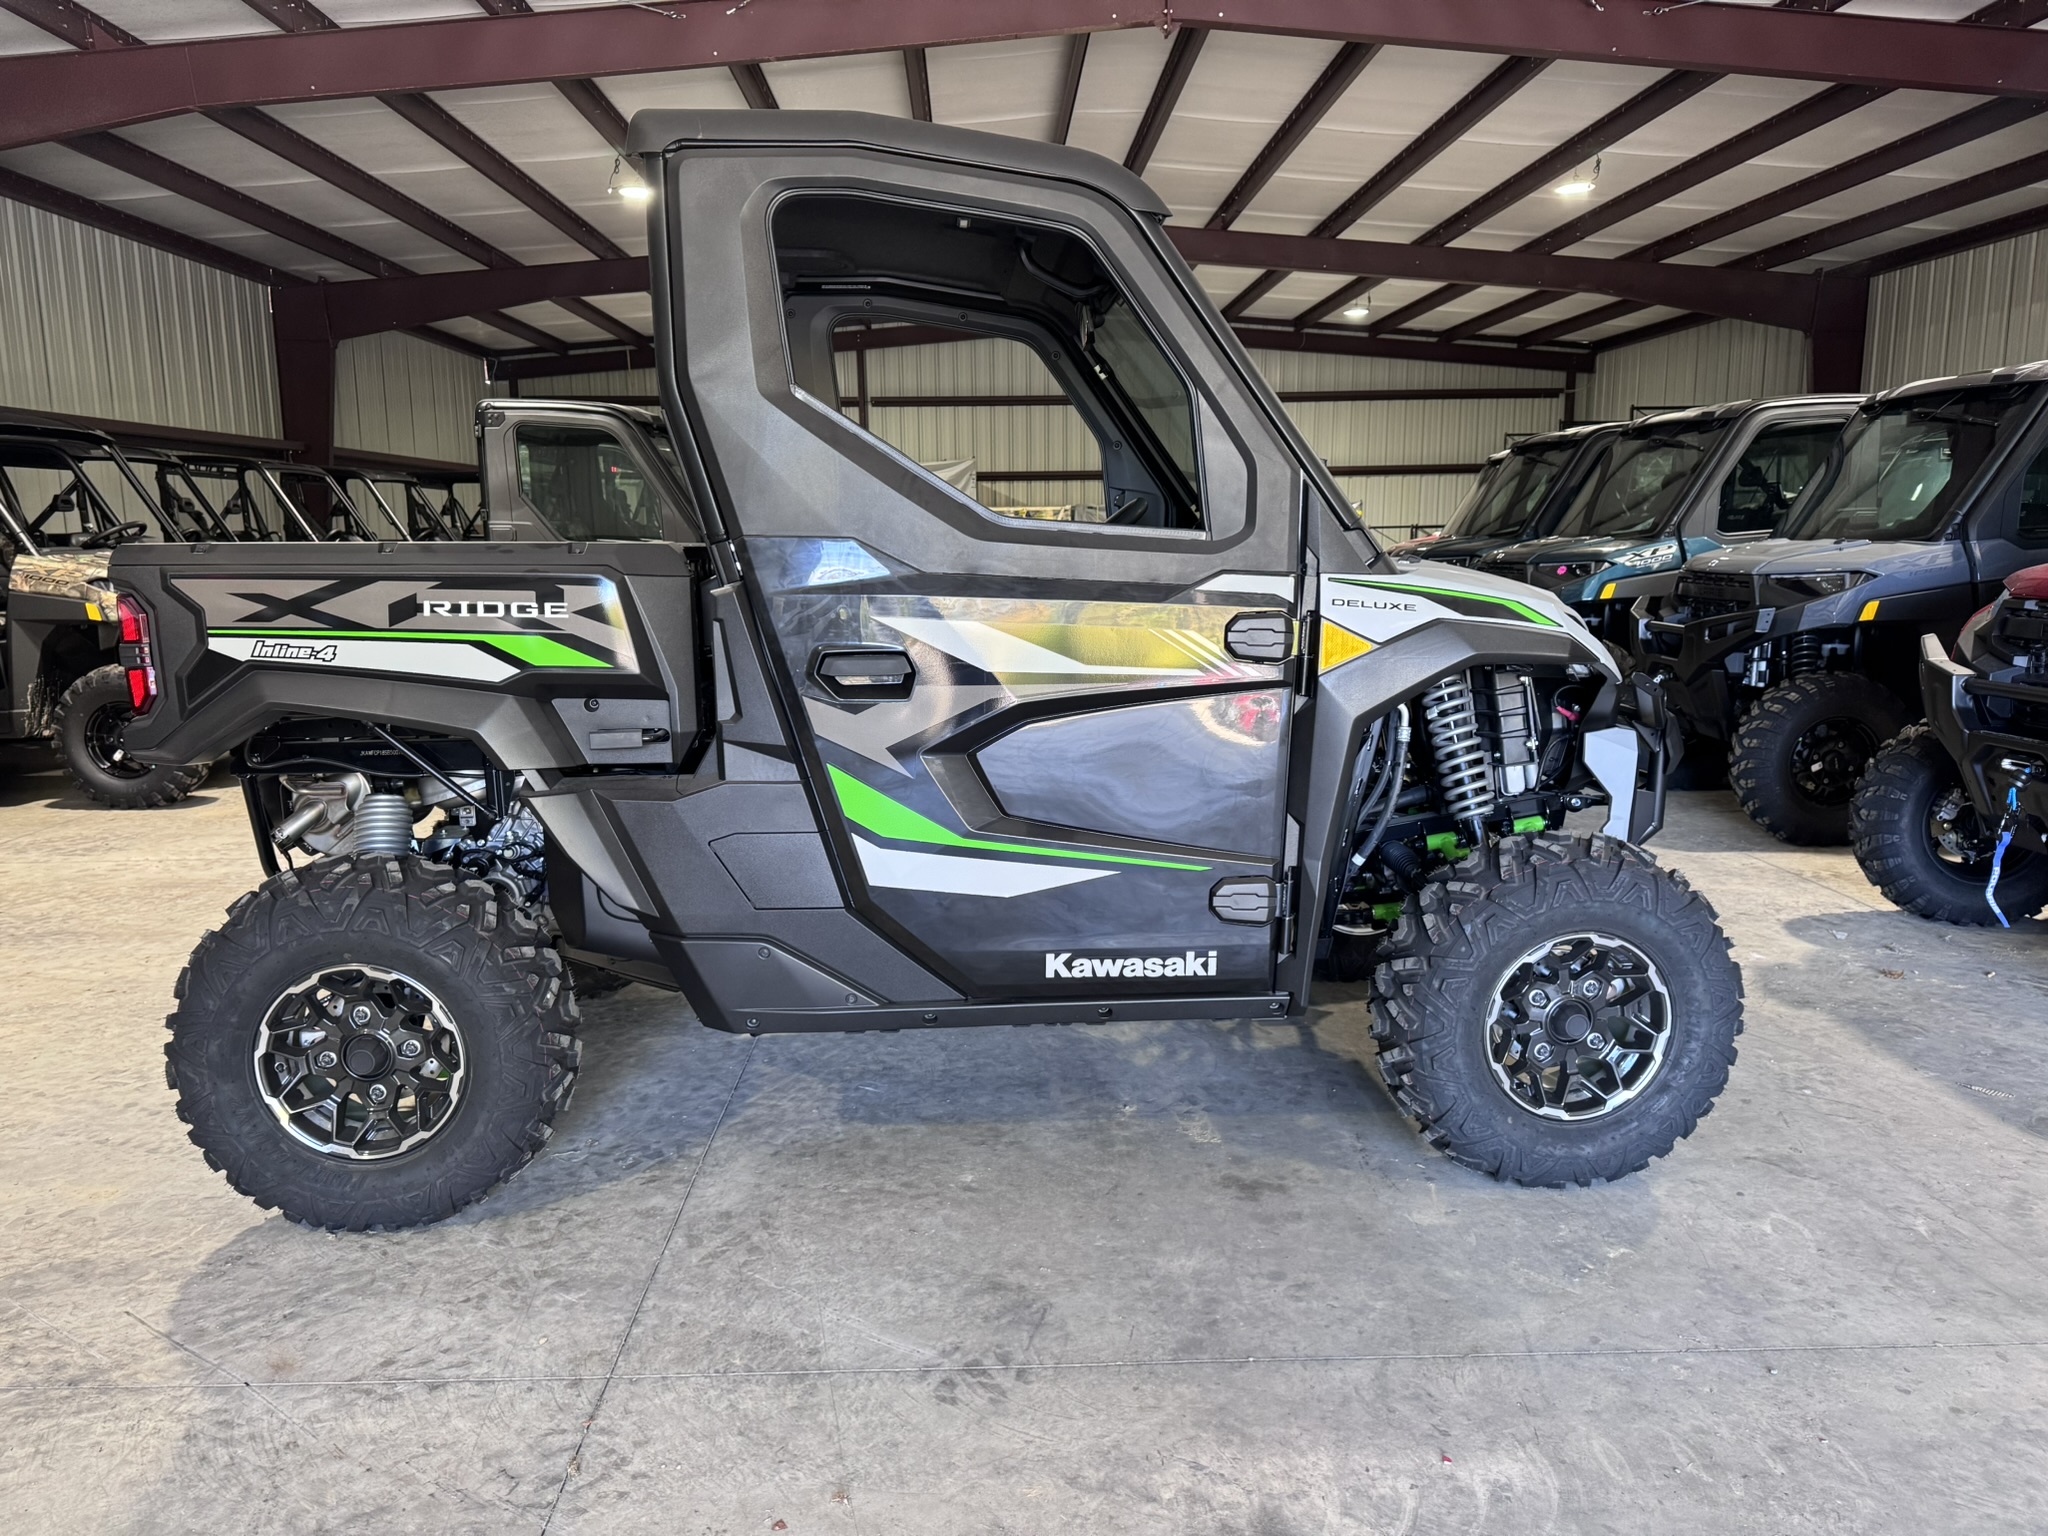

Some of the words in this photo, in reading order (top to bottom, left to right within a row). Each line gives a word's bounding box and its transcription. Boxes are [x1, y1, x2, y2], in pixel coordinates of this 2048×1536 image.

[1613, 544, 1677, 565] XP
[1635, 554, 1673, 567] 1000
[22, 561, 84, 577] XP
[24, 573, 70, 586] 1000
[423, 600, 569, 618] RIDGE
[1331, 598, 1417, 612] DELUXE
[250, 640, 338, 662] Inline-4
[1045, 950, 1218, 979] Kawasaki
